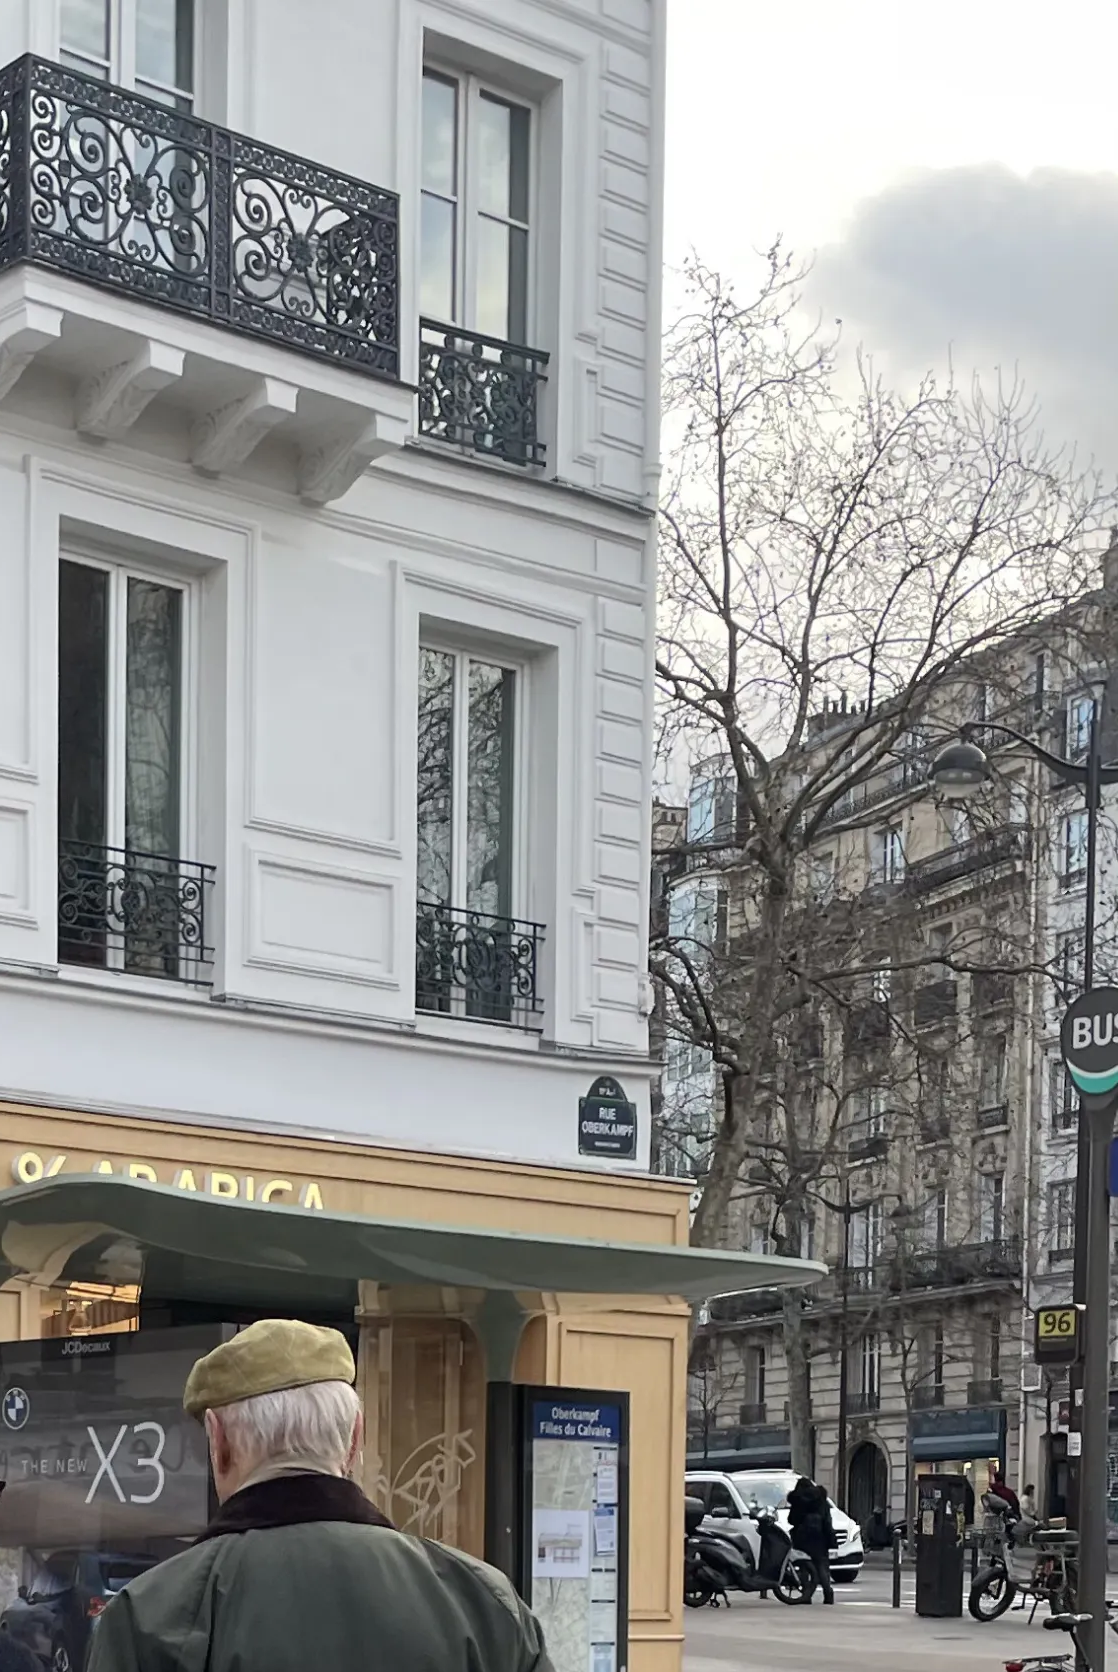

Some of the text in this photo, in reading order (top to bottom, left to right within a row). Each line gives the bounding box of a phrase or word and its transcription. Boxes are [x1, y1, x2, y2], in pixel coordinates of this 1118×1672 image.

[1072, 1013, 1118, 1050] BU
[599, 1107, 617, 1120] RUE
[582, 1121, 634, 1137] OBERKAMPF
[95, 1160, 324, 1210] ABICA
[1043, 1312, 1071, 1334] 96
[551, 1406, 601, 1425] Oberkampf
[539, 1421, 612, 1438] Filles du Calvaire
[21, 1421, 166, 1504] THE NEW X3
